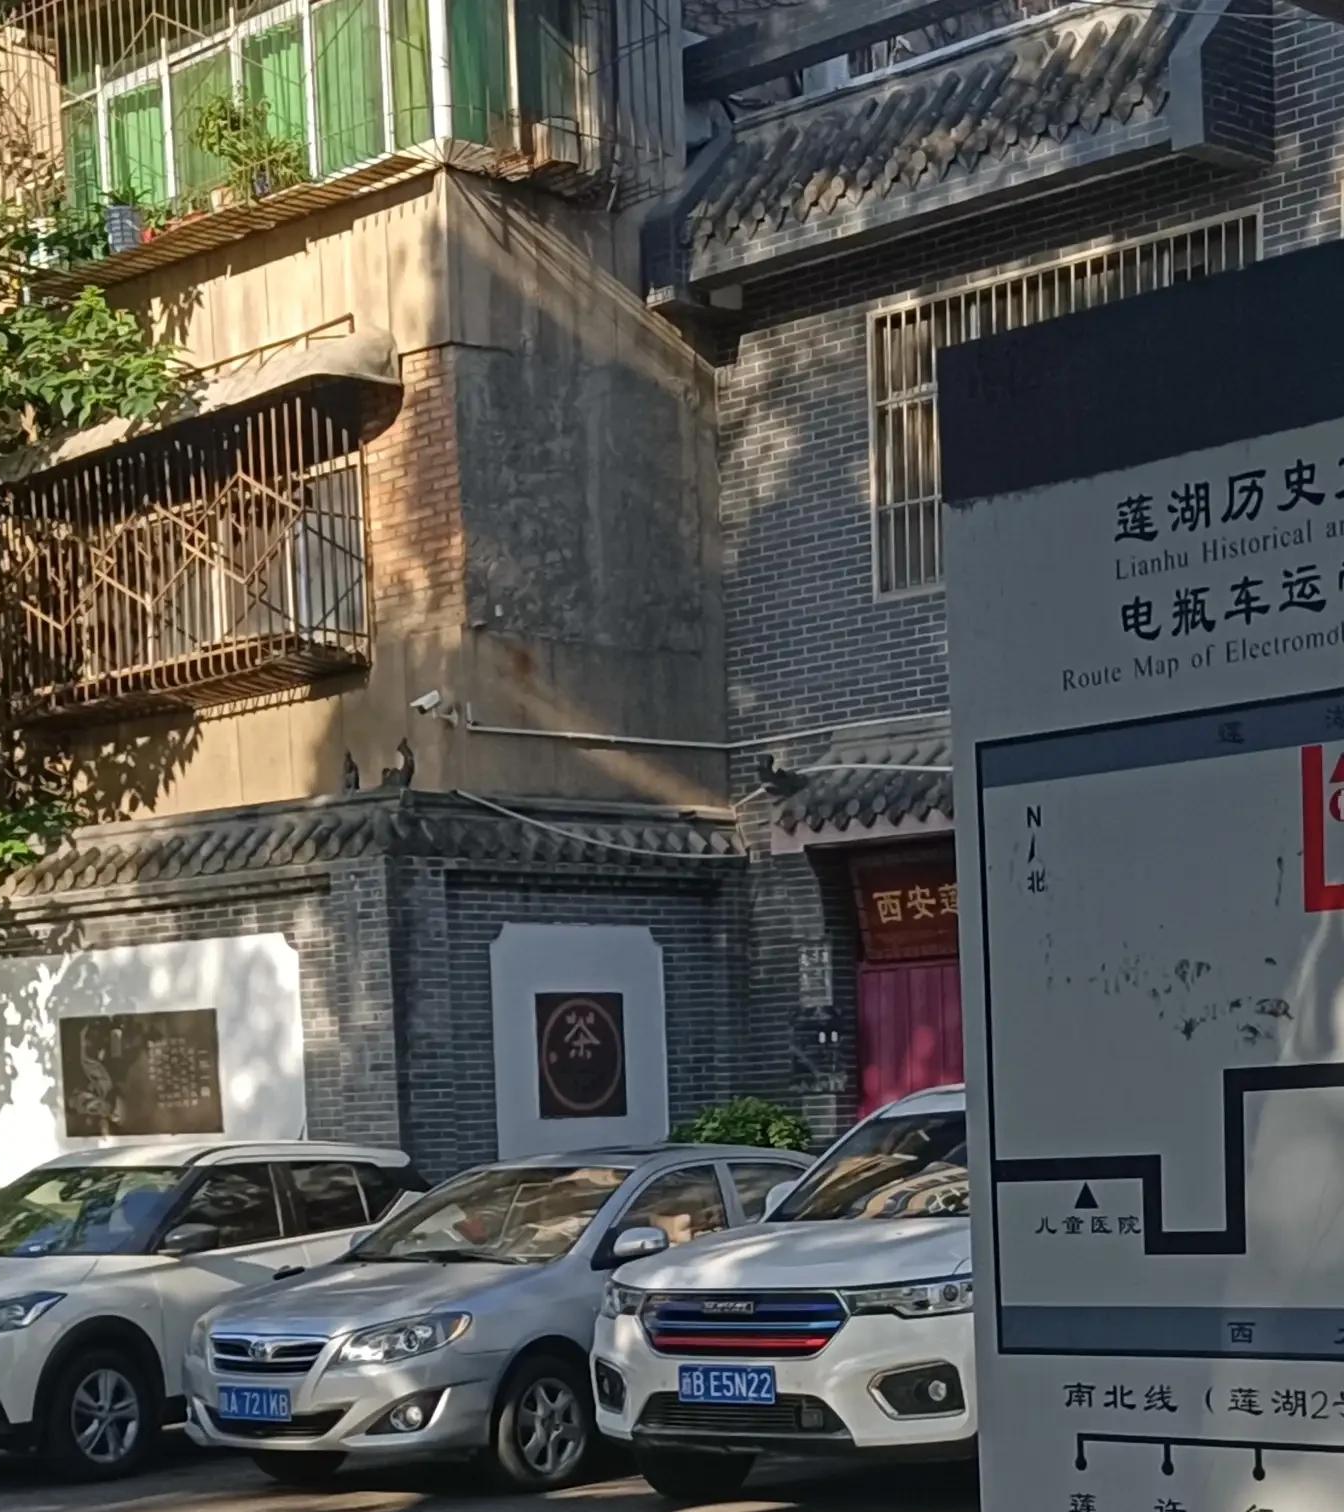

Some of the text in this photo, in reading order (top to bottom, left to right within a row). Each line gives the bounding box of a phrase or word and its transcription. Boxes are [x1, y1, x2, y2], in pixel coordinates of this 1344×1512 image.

[1114, 547, 1189, 581] Lianhu
[1200, 517, 1312, 564] Historical
[1061, 664, 1122, 692] Route
[1132, 654, 1179, 679] Map
[1189, 642, 1216, 669] of
[1025, 804, 1042, 829] N
[1025, 867, 1046, 895] 北
[1033, 1213, 1142, 1235] 儿童医院
[220, 1386, 292, 1420] A721KB
